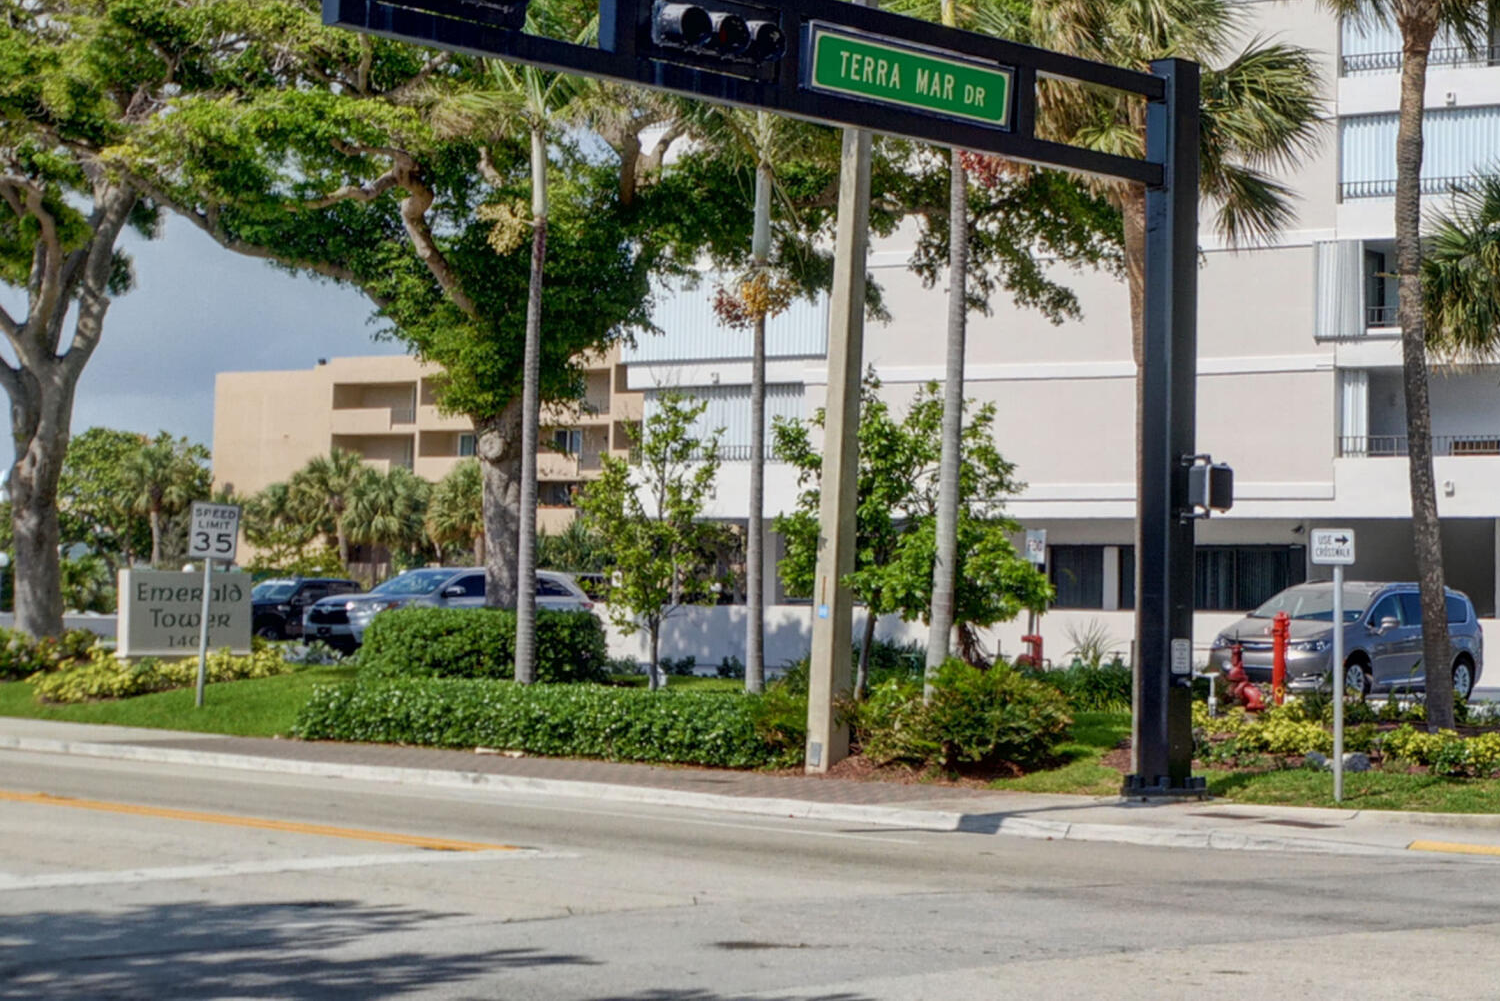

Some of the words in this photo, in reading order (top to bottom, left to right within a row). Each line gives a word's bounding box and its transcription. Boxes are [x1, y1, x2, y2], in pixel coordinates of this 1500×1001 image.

[840, 51, 901, 89] TERRA
[916, 68, 955, 100] MAR
[964, 84, 986, 107] DR
[195, 508, 236, 519] SPEED
[198, 521, 231, 530] LIMIT
[194, 532, 232, 553] 35
[1317, 535, 1332, 545] USE
